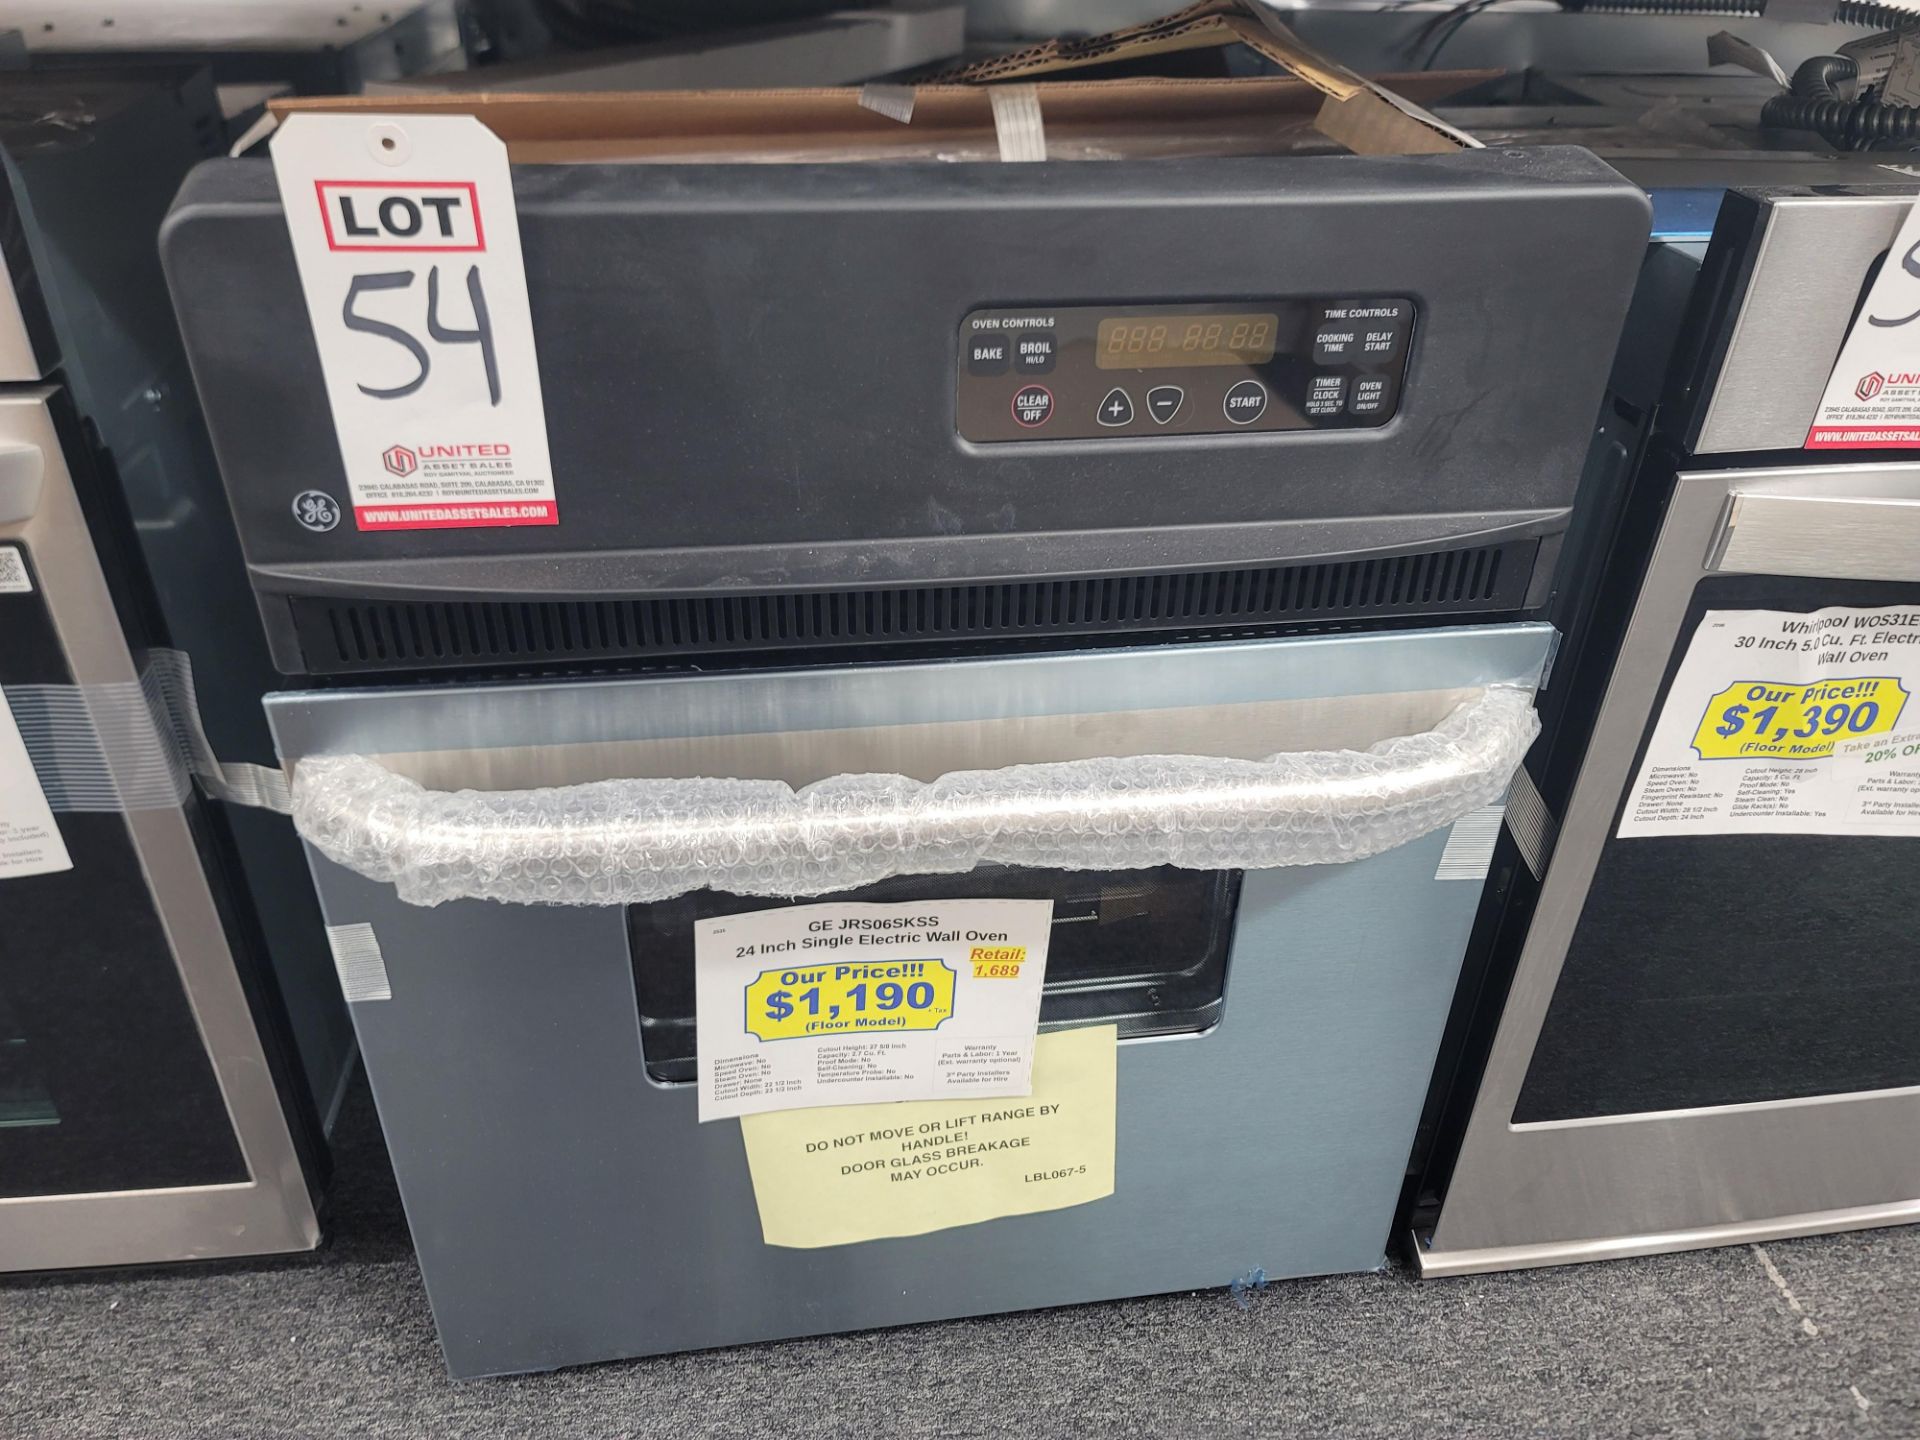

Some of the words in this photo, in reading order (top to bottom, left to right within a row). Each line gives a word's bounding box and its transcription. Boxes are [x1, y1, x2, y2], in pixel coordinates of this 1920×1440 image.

[339, 196, 460, 238] LOT
[1325, 310, 1347, 318] TIME
[1349, 308, 1398, 318] CONTROLS
[972, 320, 1000, 329] OVEN
[1002, 317, 1055, 328] CONTROLS
[344, 264, 502, 407] 54
[1317, 333, 1354, 343] COOKING
[1366, 332, 1393, 341] DELAY
[1020, 342, 1052, 354] BROIL
[1324, 343, 1344, 353] TIME
[1364, 342, 1391, 351] START
[974, 348, 1002, 360] BAKE
[1025, 356, 1045, 364] HI/LO
[1315, 378, 1341, 387] TIMER
[1360, 382, 1382, 390] OVEN
[1017, 394, 1049, 407] CLEAR
[1229, 396, 1262, 408] START
[1313, 391, 1339, 400] CLOCK
[1357, 392, 1381, 401] LIGHT
[1023, 410, 1042, 421] OFF
[418, 444, 511, 458] UNITED
[364, 506, 548, 523] WWW.UNITEDASSETSALES.COM
[1782, 615, 1849, 635] Whirlpool
[1734, 636, 1755, 648] 30
[1758, 637, 1797, 651] Inch
[1801, 637, 1820, 652] 5.0
[1821, 633, 1843, 646] Cu.
[1849, 634, 1867, 646] Ft.
[1872, 631, 1920, 644] Electr
[1817, 651, 1846, 666] Wall
[1849, 651, 1889, 663] Oven
[1747, 685, 1795, 703] Our
[1800, 681, 1880, 704] Price!!!
[1716, 701, 1880, 743] $1,390
[1739, 741, 1785, 754] (Floor
[1786, 741, 1835, 754] Model)
[1844, 742, 1870, 753] Take
[1865, 747, 1896, 763] 20%
[808, 920, 834, 932] GE
[838, 916, 940, 931] JRS06SKSS
[736, 945, 757, 958] 24
[760, 940, 796, 954] Inch
[801, 933, 854, 951] Single
[859, 931, 921, 946] Electric
[926, 930, 960, 943] Wall
[965, 930, 1008, 942] Oven
[970, 947, 1026, 961] Retail:
[780, 970, 827, 986] Our
[835, 963, 925, 980] Price!!!
[974, 965, 1020, 978] 1,689
[765, 981, 935, 1022] $1,190
[805, 1019, 850, 1033] (Floor
[854, 1016, 906, 1028] Model)
[715, 1053, 759, 1065] Dimensions
[715, 1069, 736, 1077] Speed
[817, 1070, 859, 1078] Temperature
[715, 1087, 738, 1095] Cutout
[805, 1140, 829, 1153] DO
[833, 1133, 865, 1149] NOT
[869, 1126, 915, 1142] MOVE
[919, 1122, 941, 1134] OR
[945, 1115, 977, 1129] LIFT
[981, 1106, 1036, 1124] RANGE
[1039, 1103, 1061, 1116] BY
[901, 1131, 969, 1152] HANDLE!
[841, 1159, 886, 1175] DOOR
[890, 1150, 942, 1168] GLASS
[946, 1136, 1031, 1158] BREAKAGE
[890, 1169, 923, 1183] MAY
[926, 1158, 984, 1177] OCCUR.
[1024, 1165, 1087, 1183] LBL067-5
